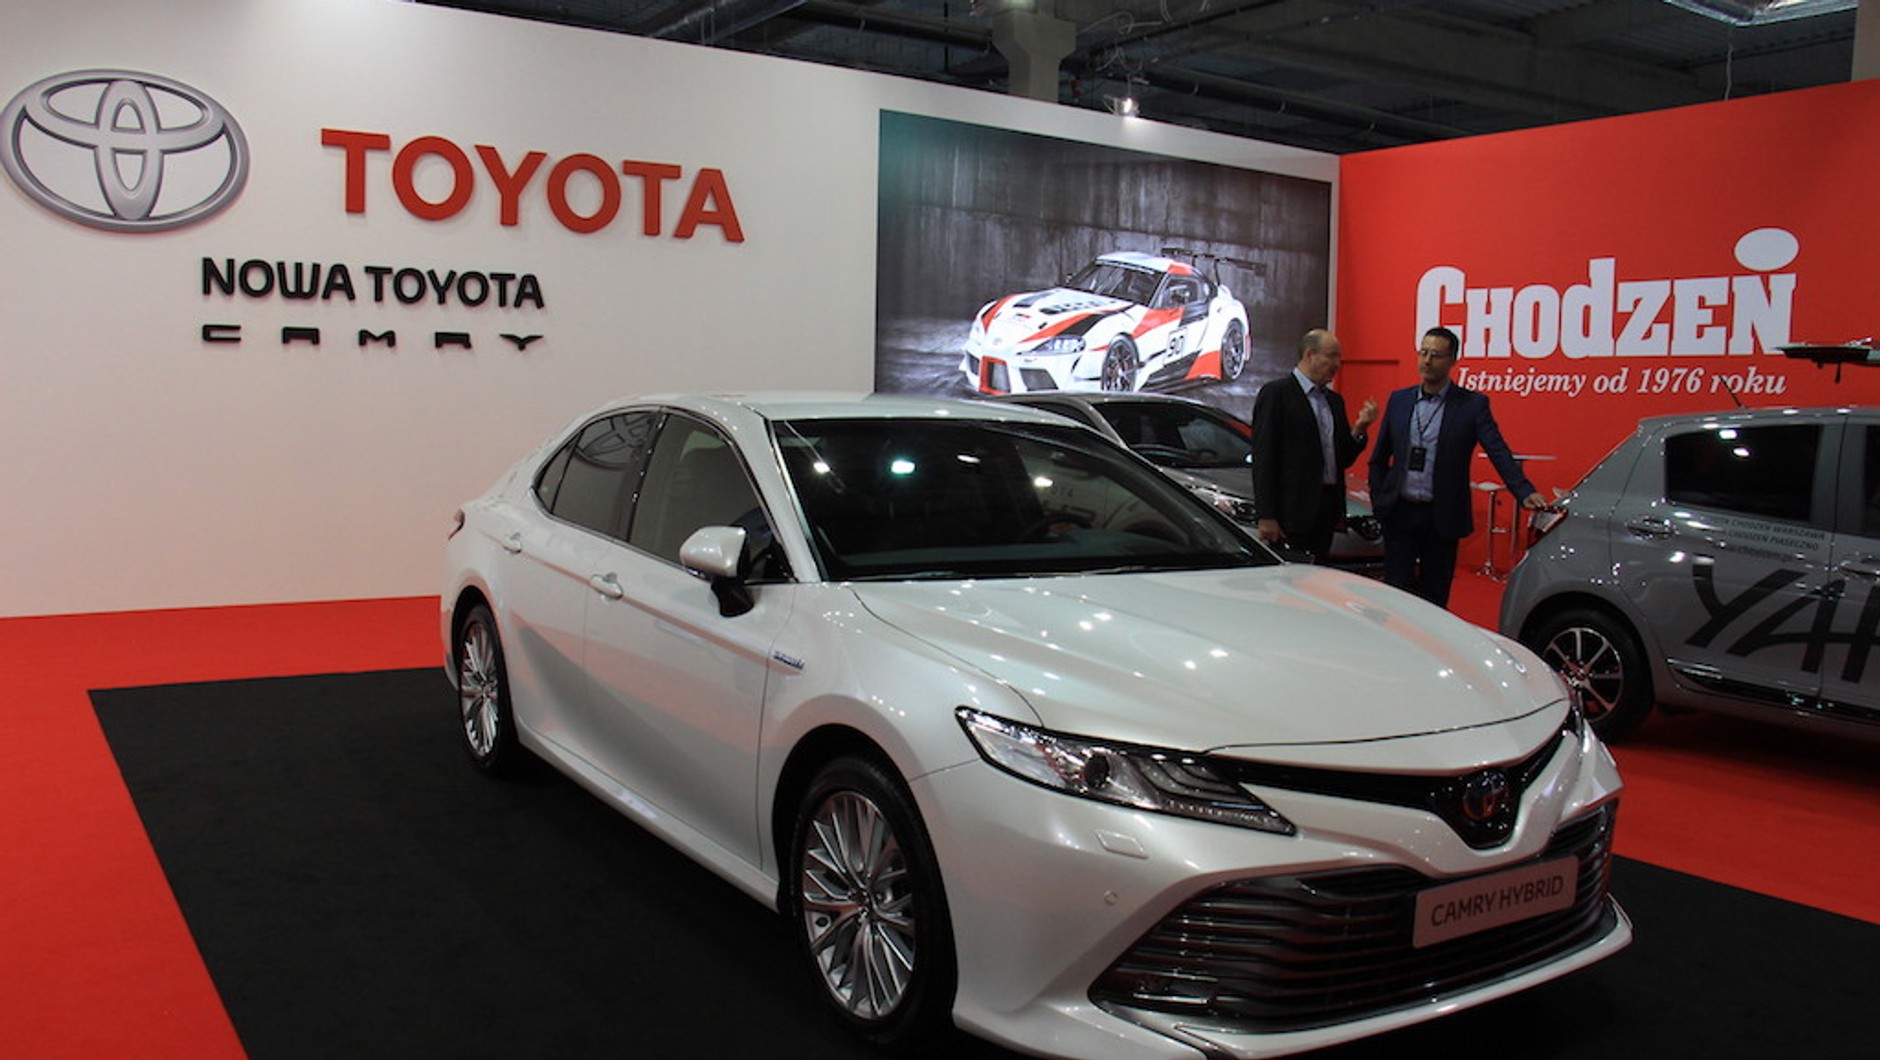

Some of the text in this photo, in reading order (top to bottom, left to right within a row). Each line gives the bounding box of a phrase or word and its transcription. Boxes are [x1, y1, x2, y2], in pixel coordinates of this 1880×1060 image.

[321, 128, 745, 243] TOYOTA
[202, 257, 545, 310] NOWA TOYOTA
[201, 324, 544, 352] CAMRY
[1457, 366, 1787, 397] Istniejemy od 1976 roku
[1431, 876, 1563, 926] CAMRY HYBRID
